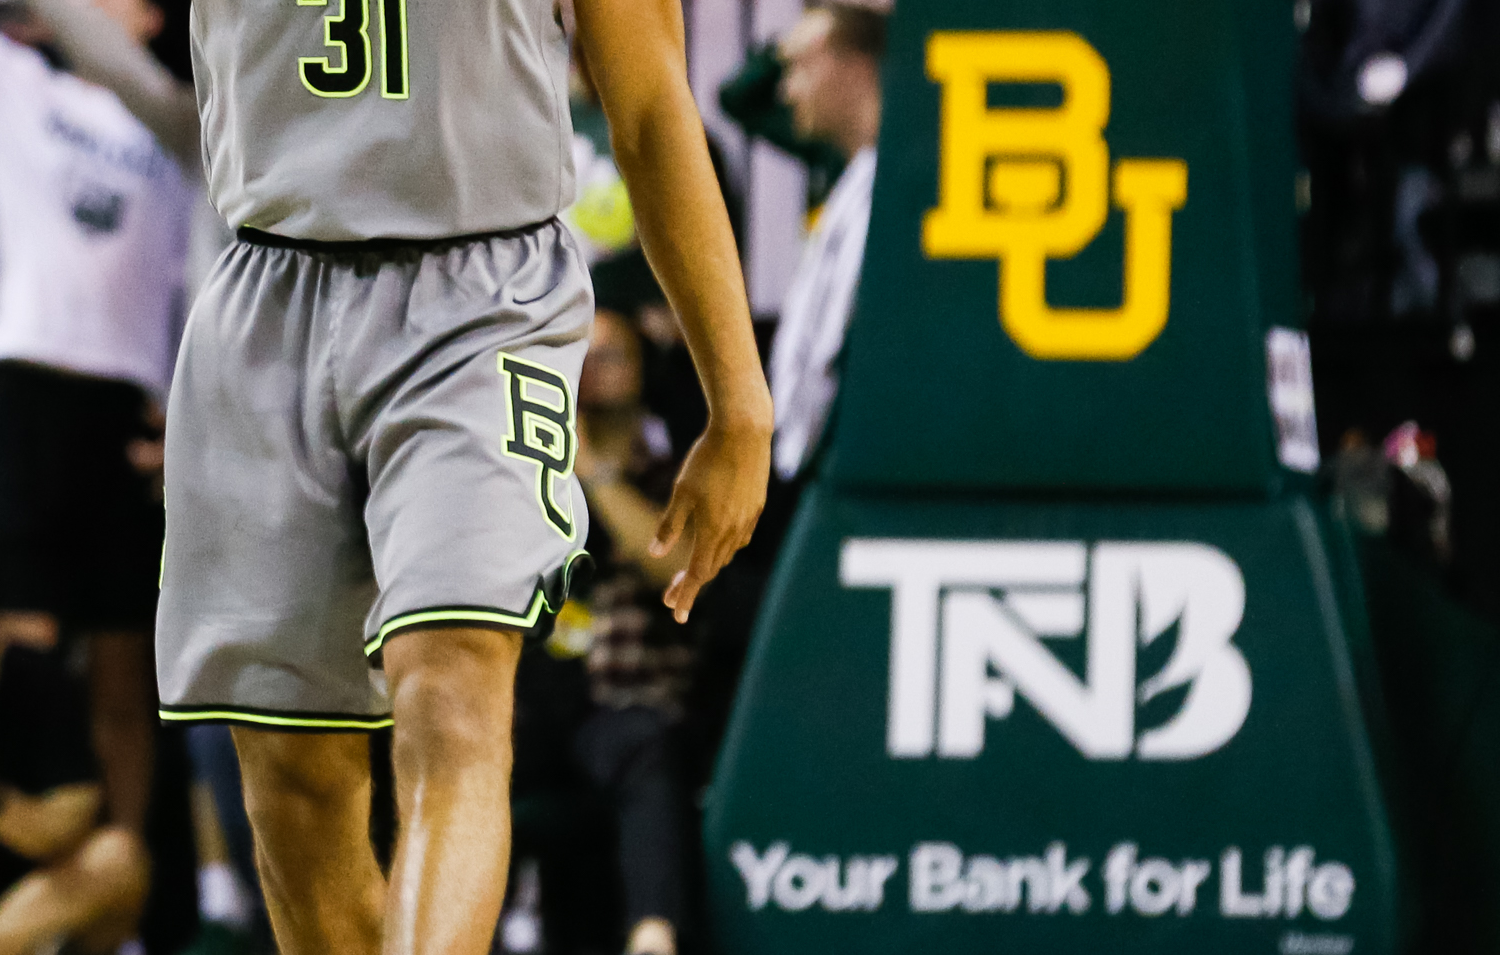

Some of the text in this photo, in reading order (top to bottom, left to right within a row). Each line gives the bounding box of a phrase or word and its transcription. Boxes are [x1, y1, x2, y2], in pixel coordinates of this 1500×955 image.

[921, 29, 1189, 361] BU
[731, 841, 1356, 921] Your Bank for Life
